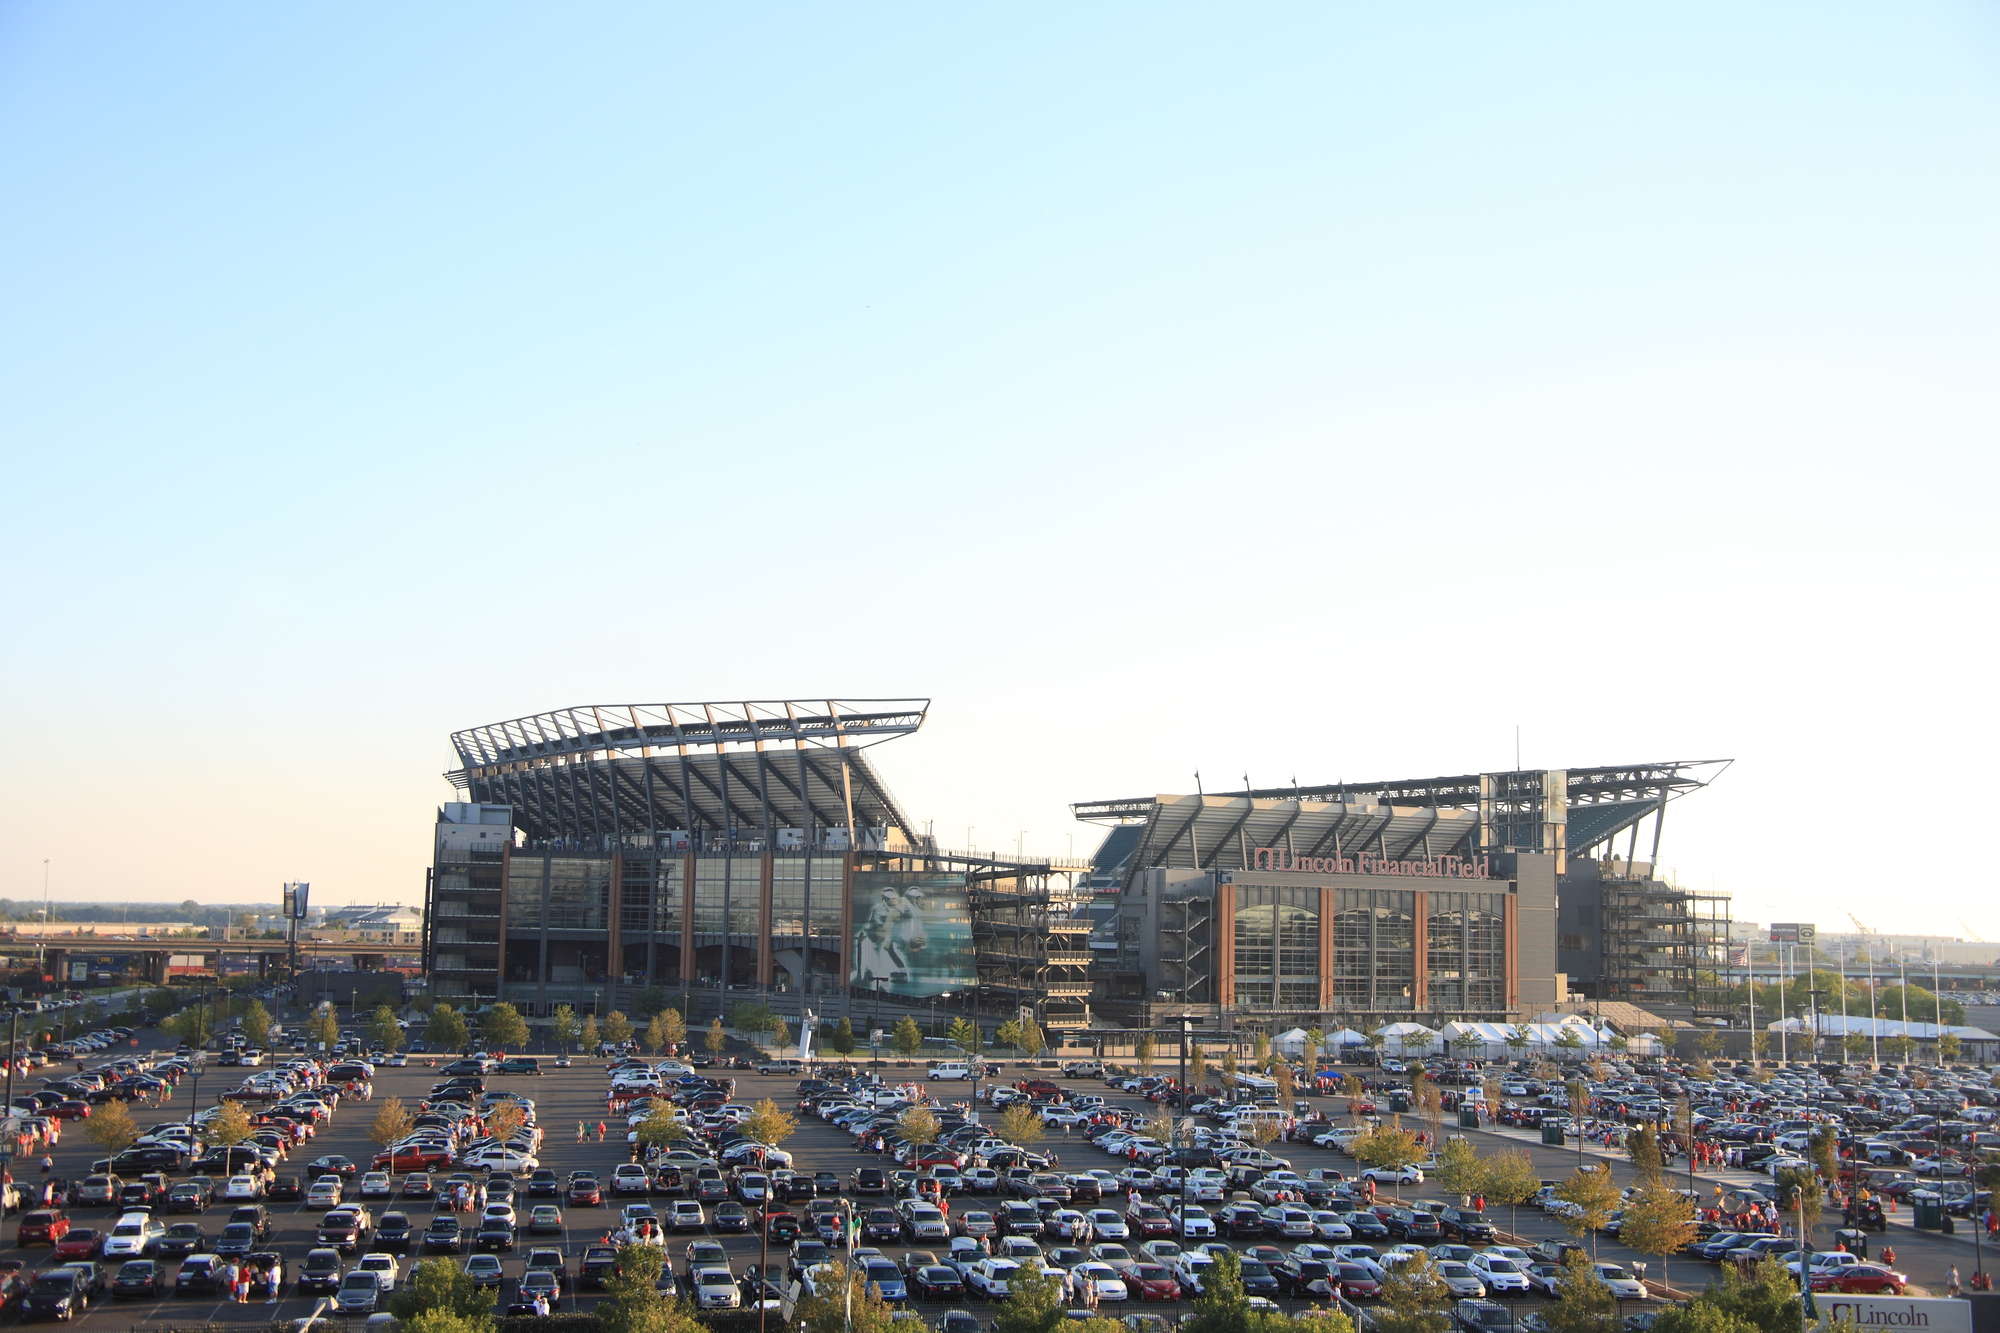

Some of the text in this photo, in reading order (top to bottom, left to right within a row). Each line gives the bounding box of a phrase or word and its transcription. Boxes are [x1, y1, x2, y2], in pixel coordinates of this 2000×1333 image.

[1278, 848, 1490, 878] Lincoln Financial Field
[1854, 1304, 1930, 1326] Lincoln
